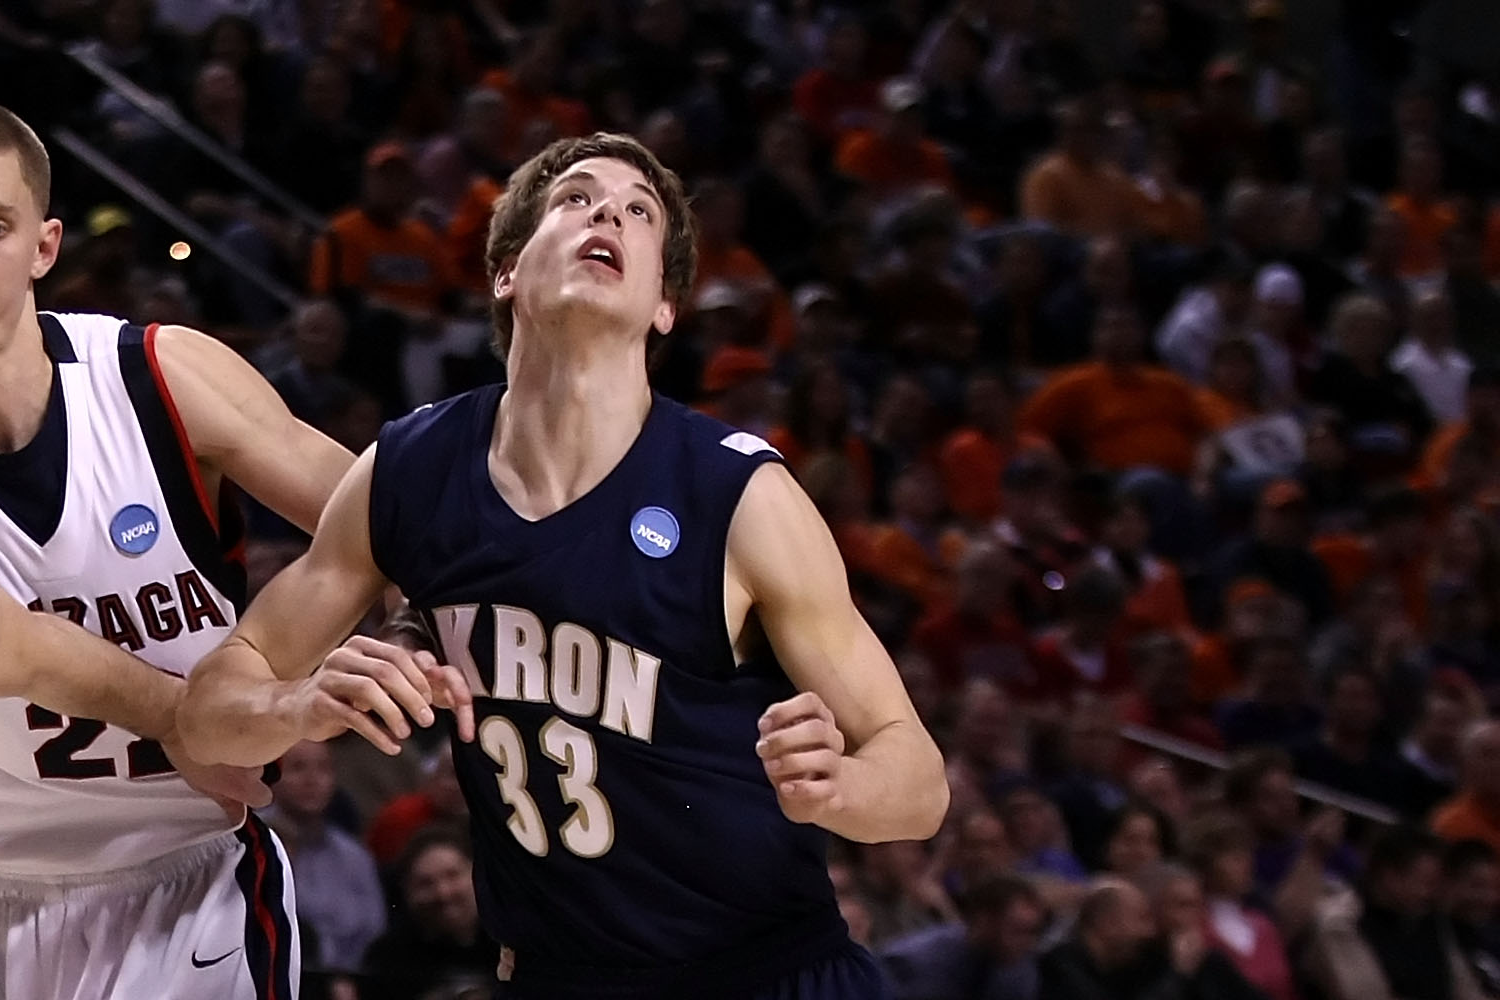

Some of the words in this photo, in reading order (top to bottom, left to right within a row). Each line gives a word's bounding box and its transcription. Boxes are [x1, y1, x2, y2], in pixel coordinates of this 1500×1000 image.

[121, 520, 156, 544] NCAA
[636, 523, 672, 551] NCAA
[478, 715, 615, 858] 33
